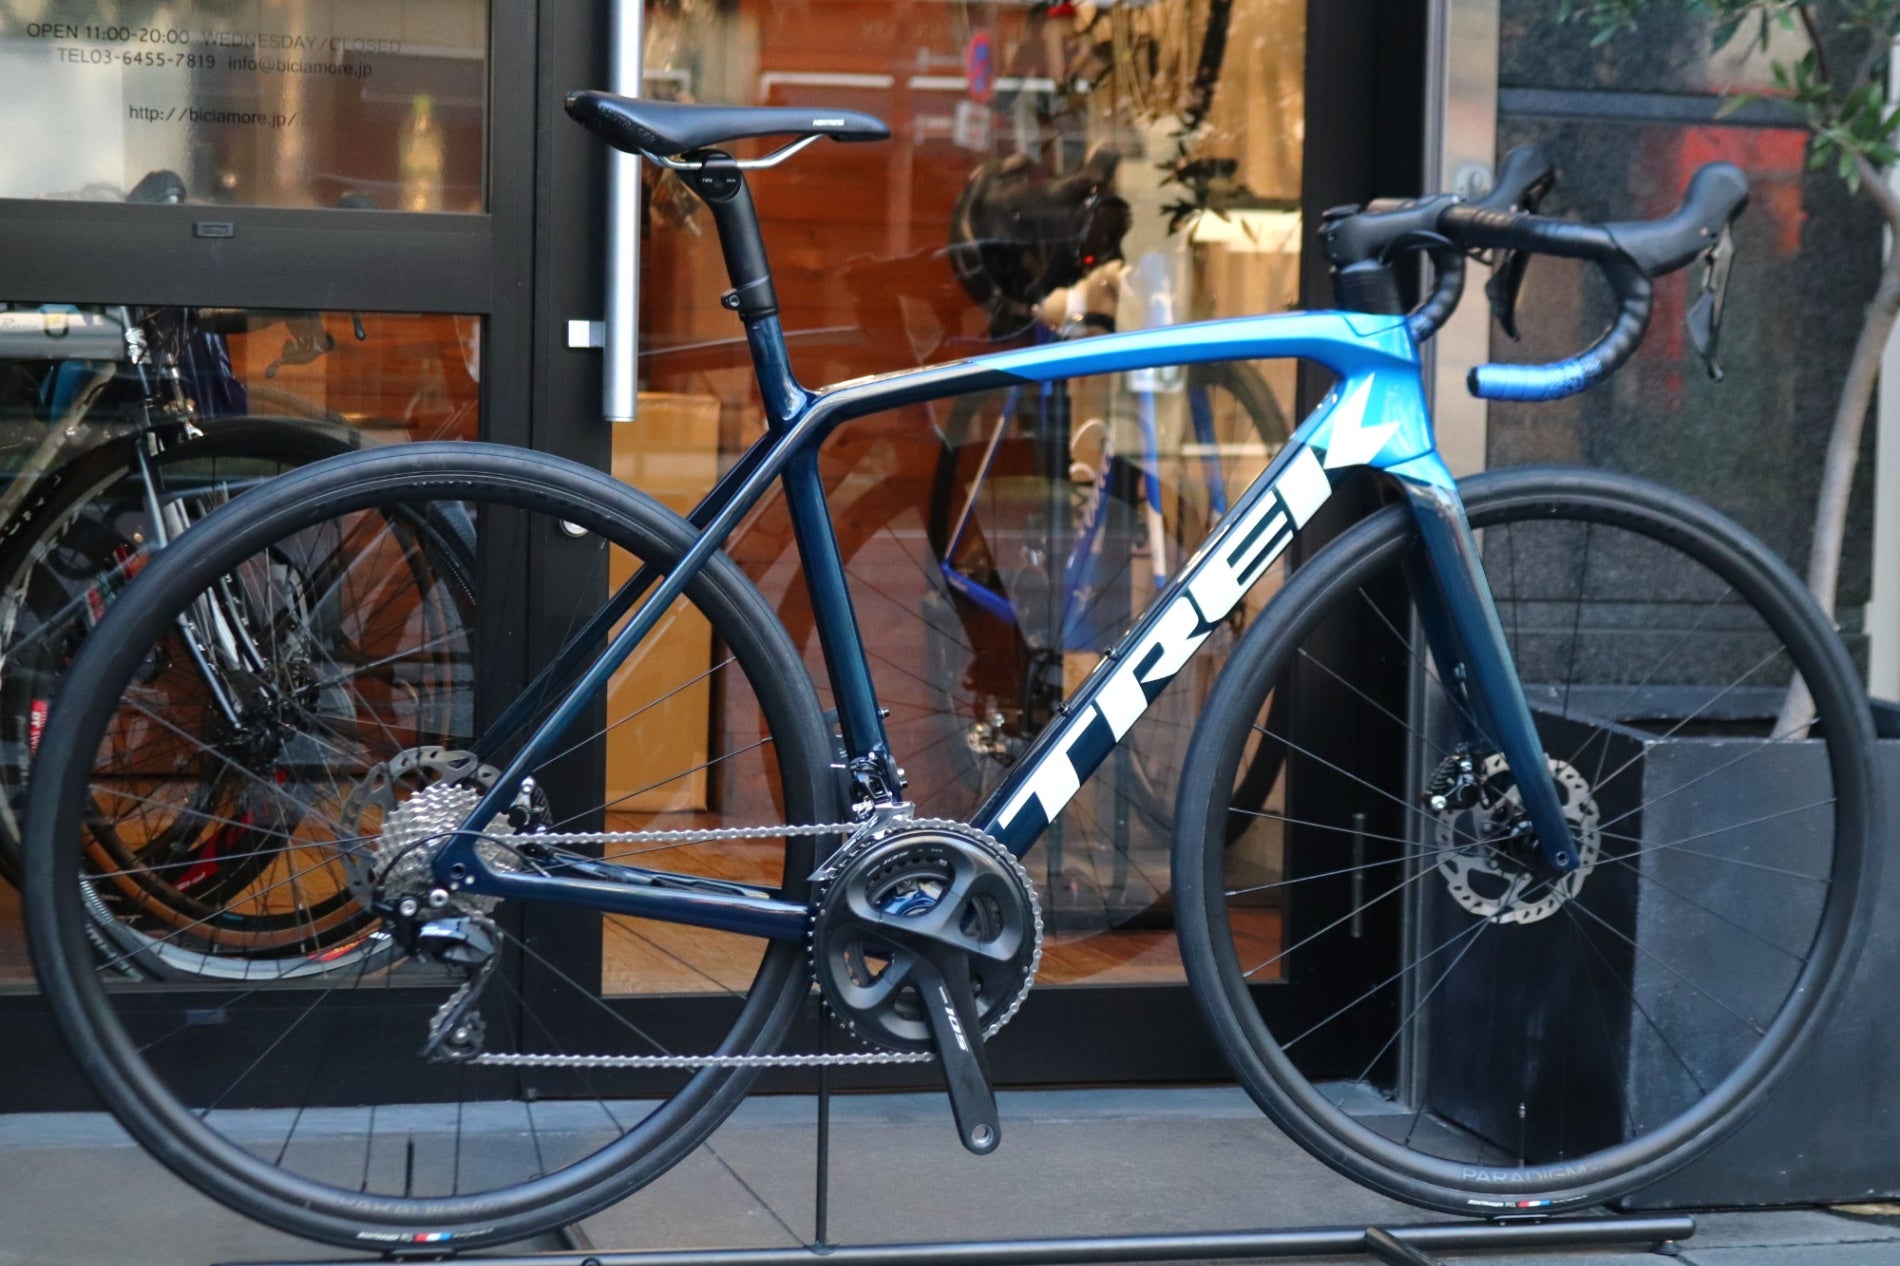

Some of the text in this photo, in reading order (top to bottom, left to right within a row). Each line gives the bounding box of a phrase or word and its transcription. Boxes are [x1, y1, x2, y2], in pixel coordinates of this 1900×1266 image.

[27, 22, 78, 39] OPEN
[86, 25, 190, 45] 11:00-20:00
[57, 47, 373, 79] TEL03-6455-7819 info@biciamore.jp
[129, 105, 297, 129] http://biciamore.jp/
[998, 372, 1401, 830] TREK
[1462, 1163, 1588, 1183] PARADIGM
